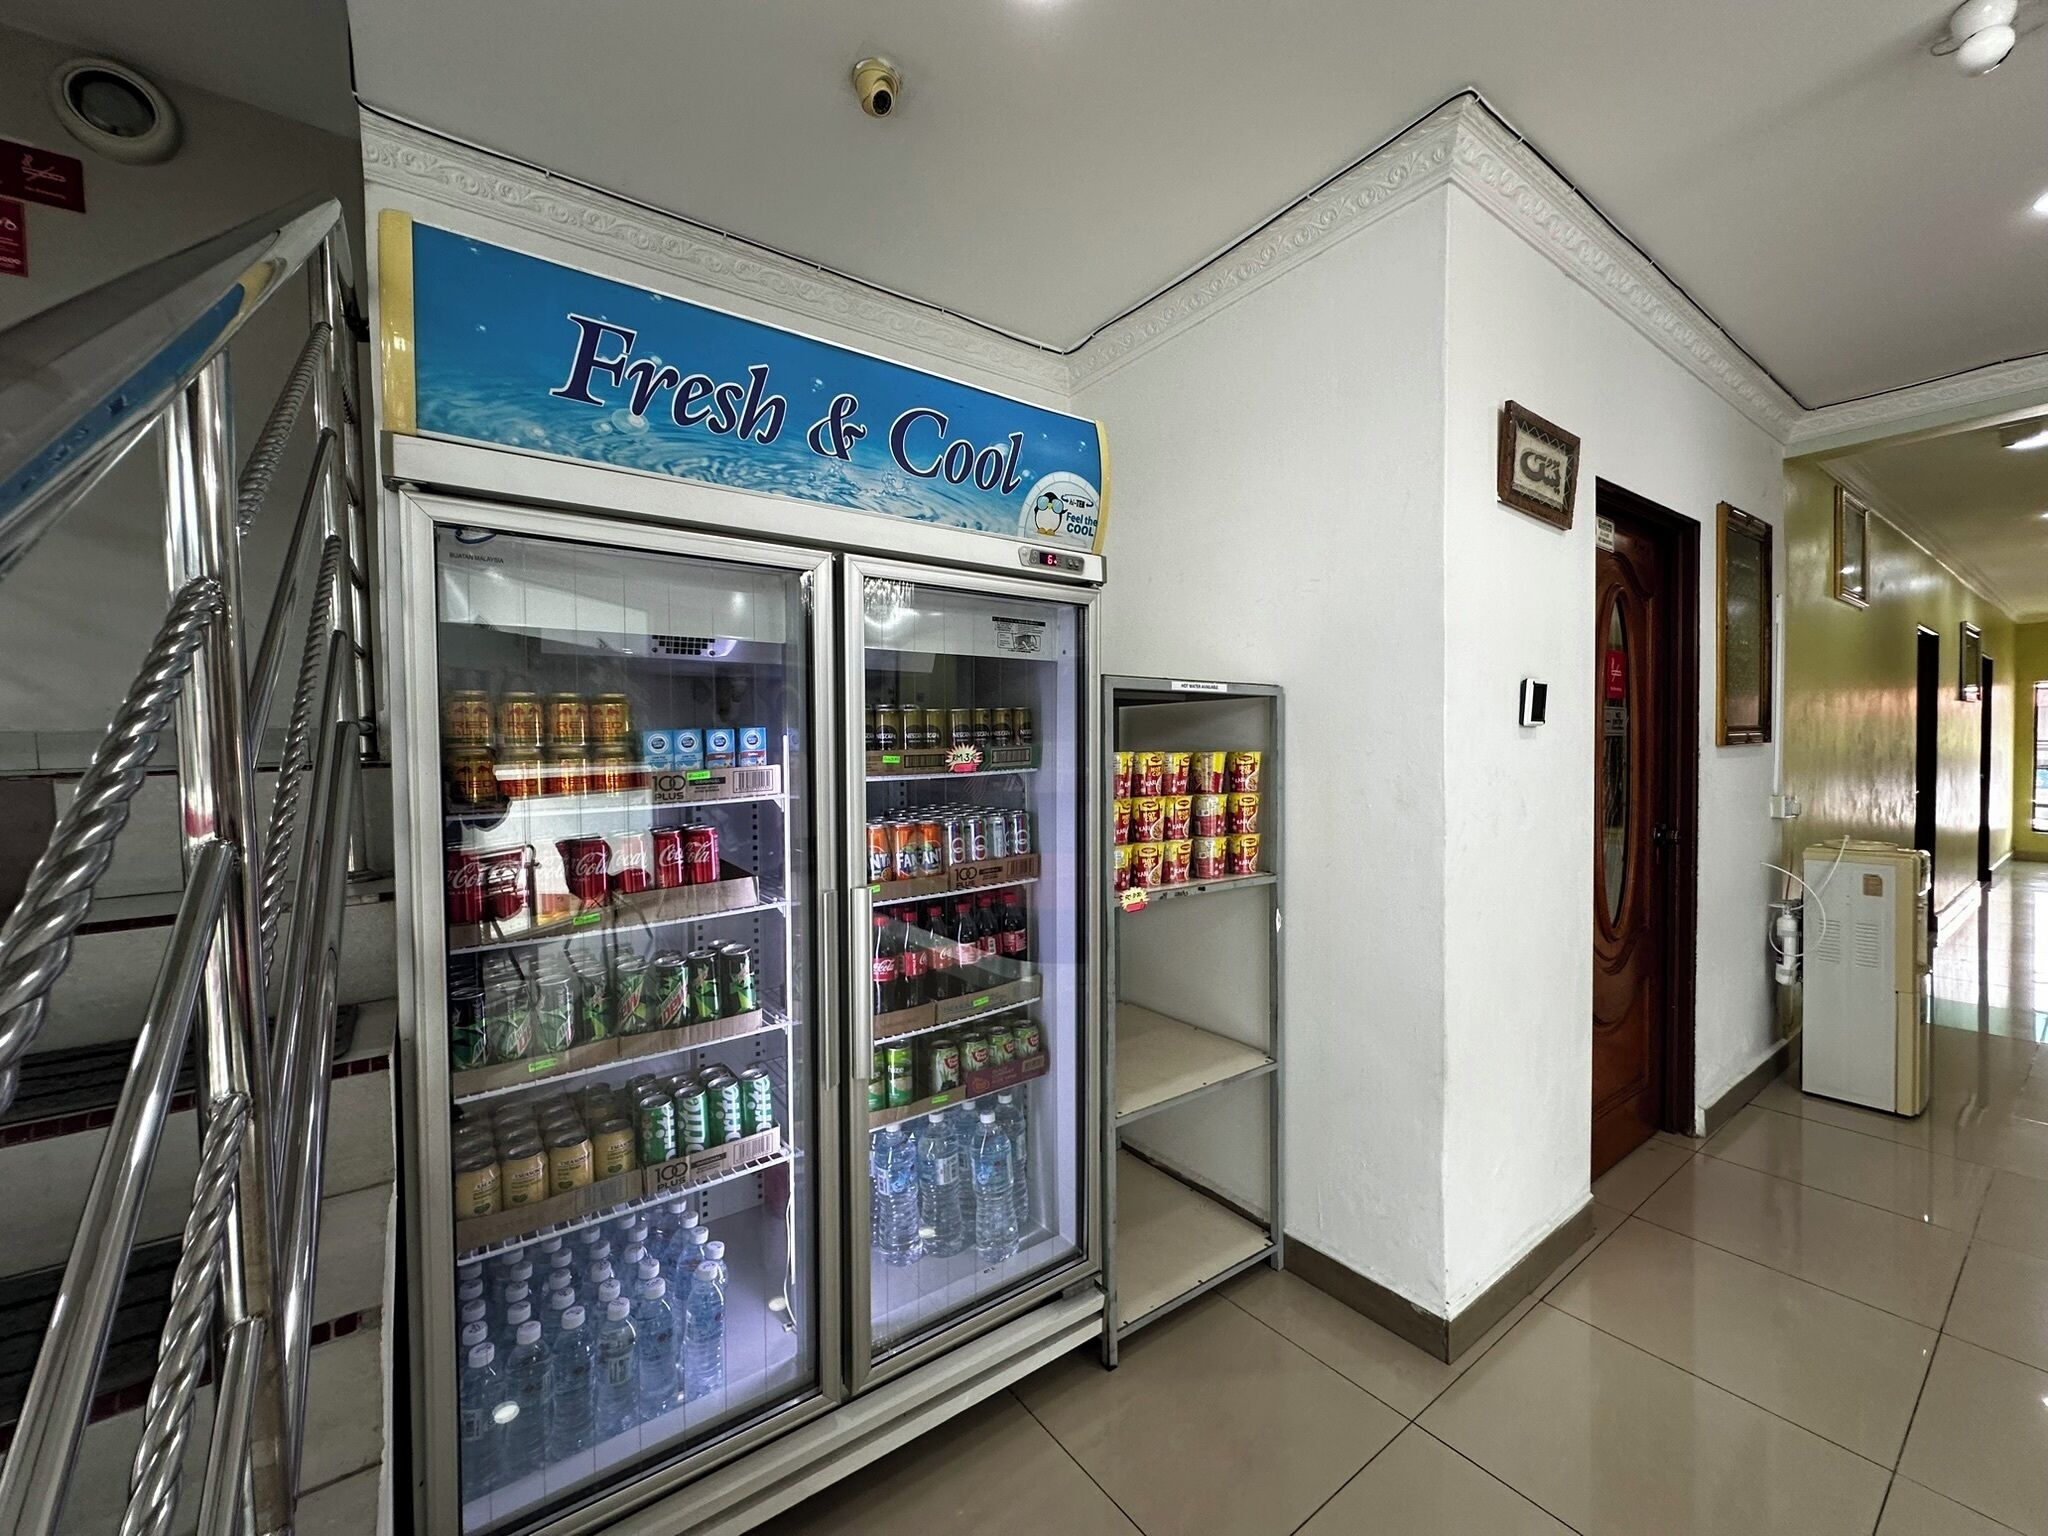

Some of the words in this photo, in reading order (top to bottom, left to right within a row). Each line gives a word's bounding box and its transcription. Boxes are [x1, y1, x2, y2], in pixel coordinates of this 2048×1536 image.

[549, 313, 787, 445] Fresh
[807, 394, 867, 462] &
[889, 408, 1024, 495] Cool
[1065, 512, 1083, 524] Feel
[1084, 515, 1098, 527] the
[1066, 523, 1094, 537] COOL
[475, 555, 504, 564] MALAYSIA
[652, 775, 687, 791] 100
[655, 791, 685, 801] PLUS
[955, 866, 977, 881] 100
[655, 1161, 688, 1184] 100
[657, 1178, 687, 1191] PLUS
